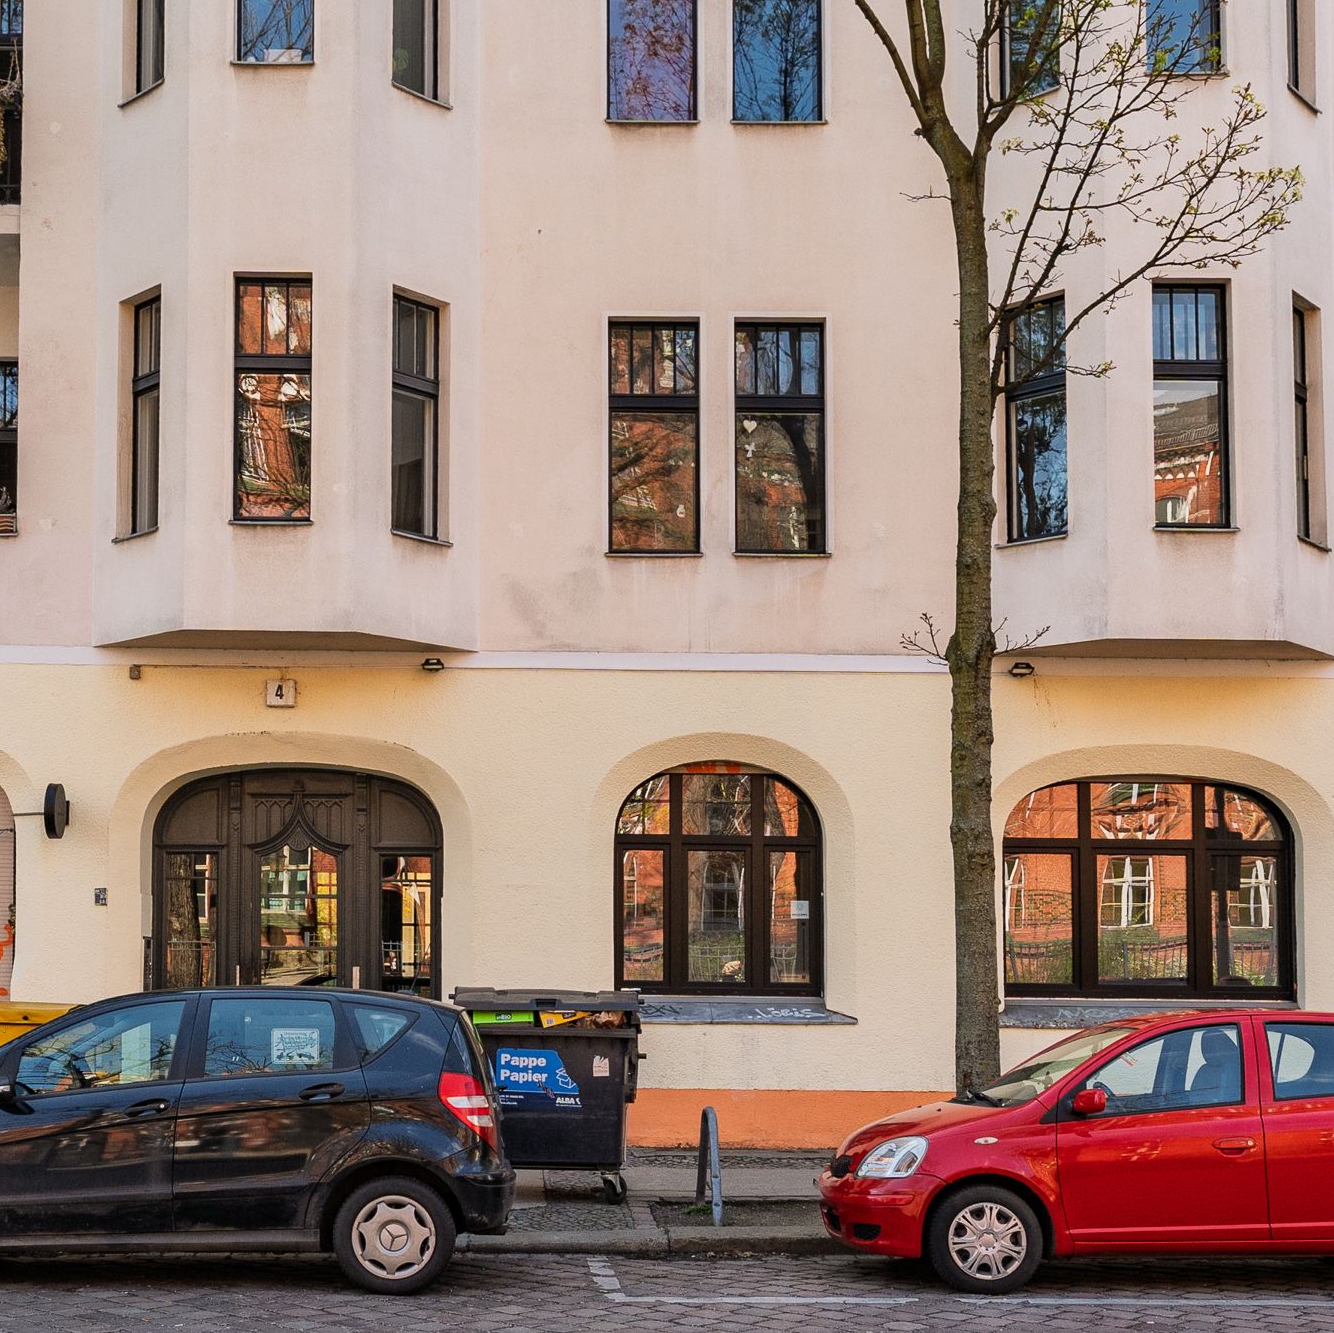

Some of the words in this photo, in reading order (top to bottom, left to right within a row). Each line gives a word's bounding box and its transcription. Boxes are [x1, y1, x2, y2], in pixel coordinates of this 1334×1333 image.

[274, 683, 285, 700] 4
[500, 1053, 547, 1068] Pappe
[500, 1069, 548, 1084] Papier
[555, 1097, 575, 1105] ALBA
